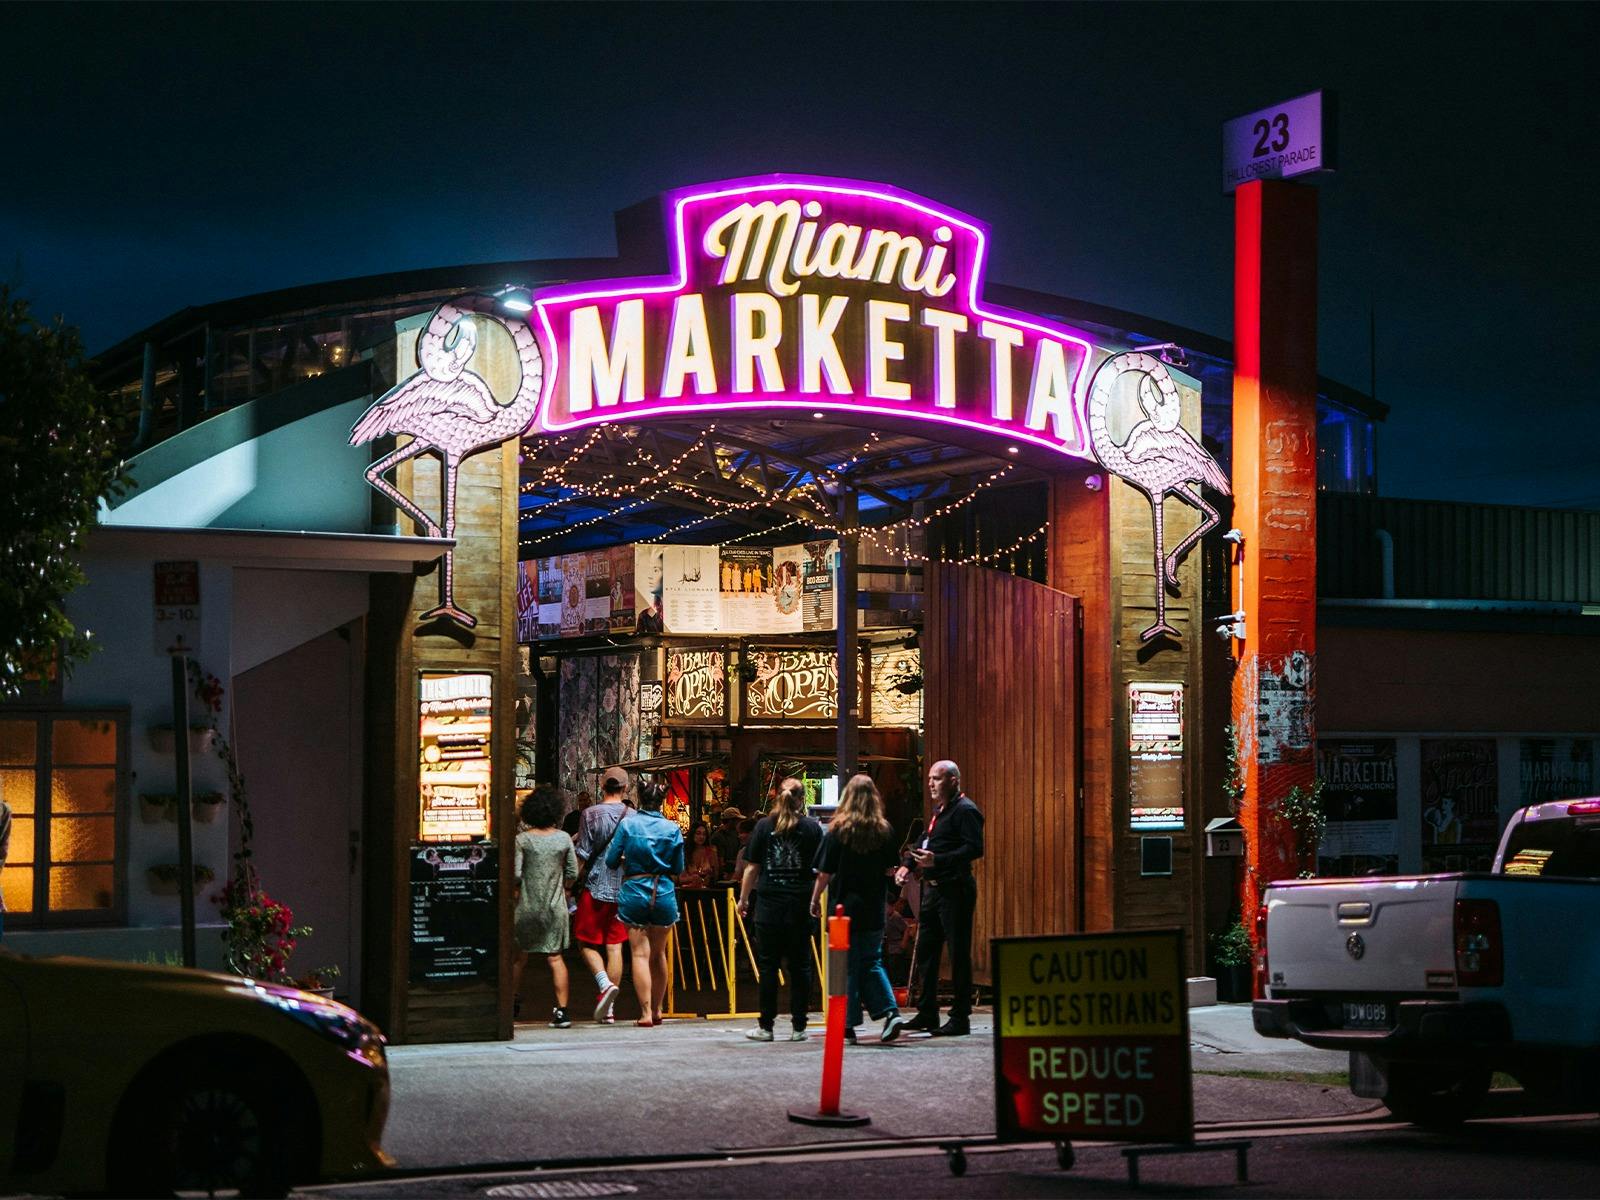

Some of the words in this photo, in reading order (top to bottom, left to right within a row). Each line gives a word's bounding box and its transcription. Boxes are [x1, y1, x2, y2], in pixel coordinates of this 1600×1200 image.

[1253, 113, 1289, 158] 23
[1227, 157, 1276, 183] HILLCREST
[1278, 146, 1316, 168] PARADE
[703, 198, 957, 298] Miami
[569, 293, 1075, 443] MARKETTA
[682, 651, 710, 672] BAR
[675, 669, 715, 714] OPEN
[765, 667, 838, 714] OPEN
[1218, 839, 1230, 851] 23
[1029, 948, 1148, 984] CAUTION
[1008, 991, 1175, 1027] PEDESTRIANS
[1029, 1046, 1155, 1080] REDUCE
[1042, 1090, 1145, 1126] SPEED
